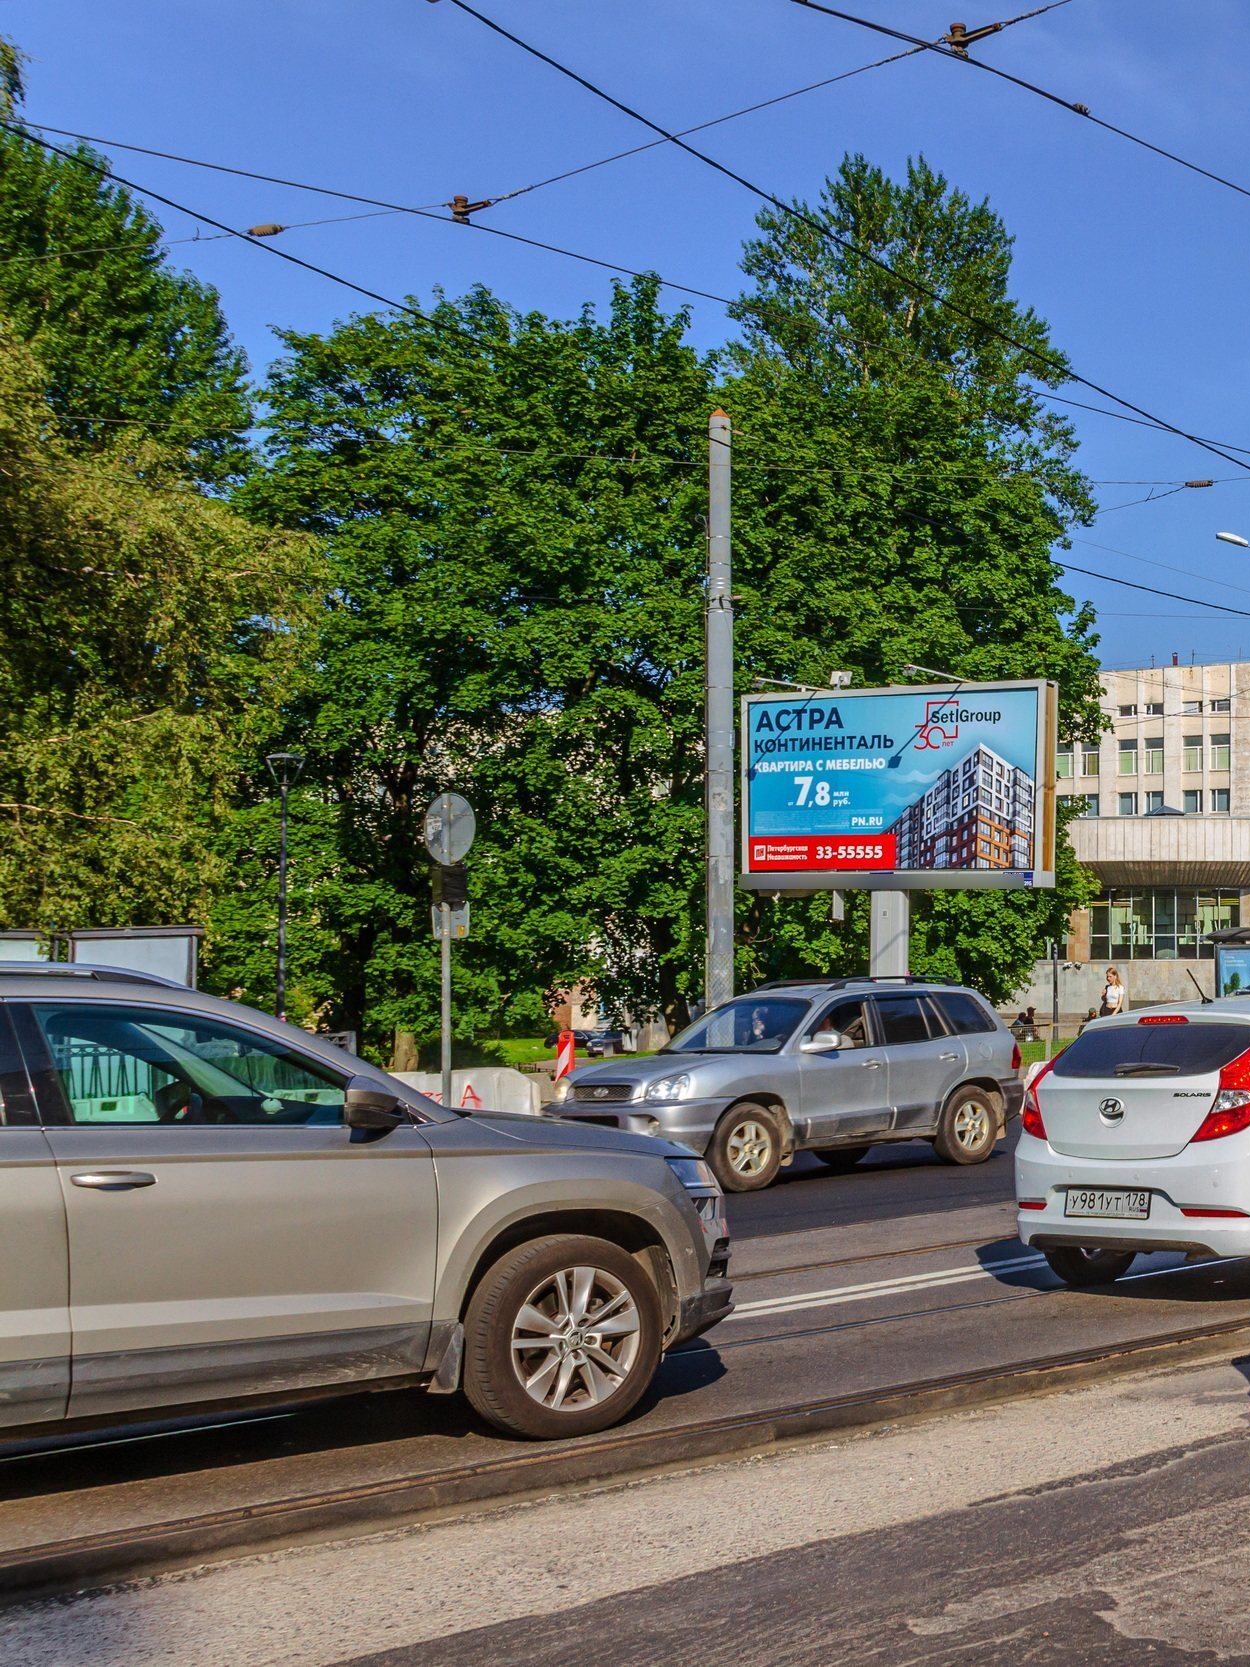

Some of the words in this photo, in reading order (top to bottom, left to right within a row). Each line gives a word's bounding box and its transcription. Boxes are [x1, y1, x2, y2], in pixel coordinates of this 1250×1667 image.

[755, 707, 844, 733] АСТРА
[754, 734, 894, 753] КОНТИНЕНТАЛЬ
[754, 759, 814, 773] КВАРТИРА
[815, 759, 824, 772] С
[825, 758, 886, 771] МЕБЕЛЬЮ
[794, 776, 831, 808] 7,8
[833, 797, 851, 807] руб.
[851, 816, 883, 826] PN.RU
[815, 845, 883, 860] 33-55555
